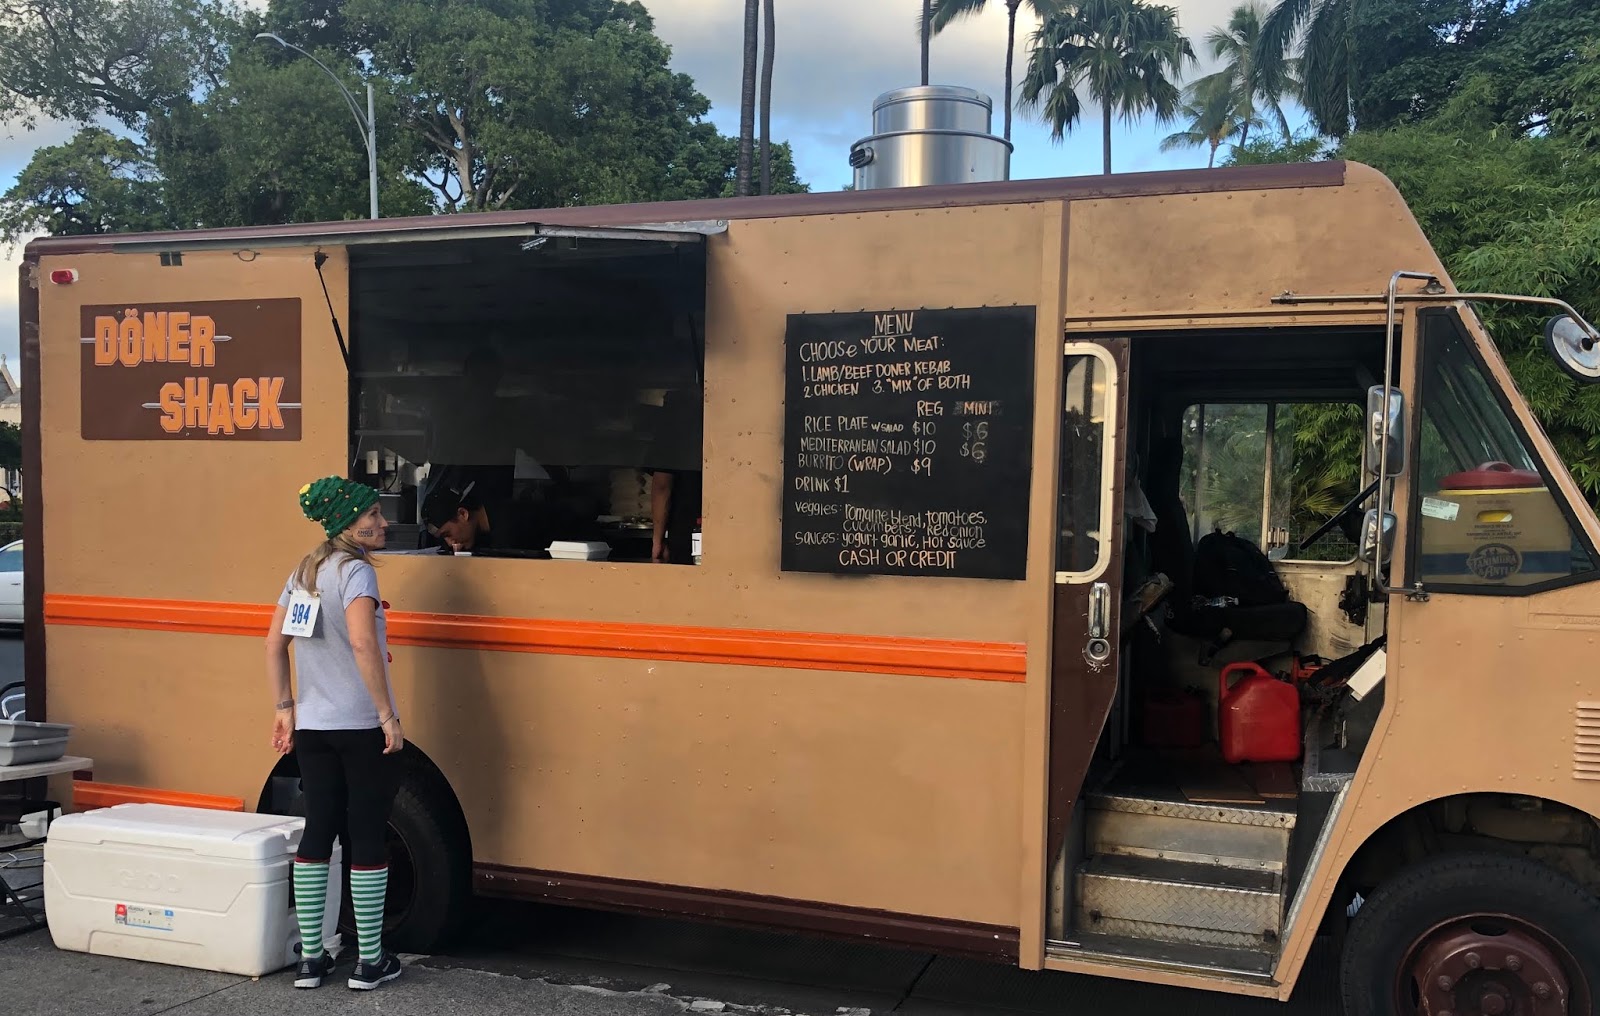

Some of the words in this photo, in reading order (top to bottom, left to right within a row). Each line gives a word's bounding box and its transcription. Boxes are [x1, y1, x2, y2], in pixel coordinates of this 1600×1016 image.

[874, 312, 914, 335] MENU
[95, 308, 216, 367] DÖNER
[860, 337, 896, 354] YOUR
[903, 336, 945, 352] MEAT:
[875, 362, 911, 378] DONER
[914, 360, 951, 376] KEBAB
[917, 377, 934, 392] OF
[938, 373, 971, 390] BOTH
[160, 377, 284, 434] SHACK
[917, 400, 944, 418] REG
[964, 401, 992, 416] MINI
[804, 415, 832, 433] RICE
[838, 415, 868, 432] PLATE
[912, 420, 936, 436] $10
[800, 436, 878, 454] MEDITERRANEAN
[880, 439, 911, 456] SALAD
[913, 438, 937, 455] $10
[960, 441, 985, 460] $6
[798, 453, 844, 471] BURRITO
[848, 454, 892, 475] (WRAP)
[911, 457, 932, 477] $9
[795, 476, 830, 493] DRINK
[834, 475, 850, 493] $1
[845, 503, 889, 522] romaine
[842, 532, 878, 548] yogurt
[949, 525, 983, 539] onion
[839, 549, 880, 566] CASH
[885, 550, 905, 567] OR
[909, 551, 957, 569] CREDIT
[291, 603, 312, 625] 984
